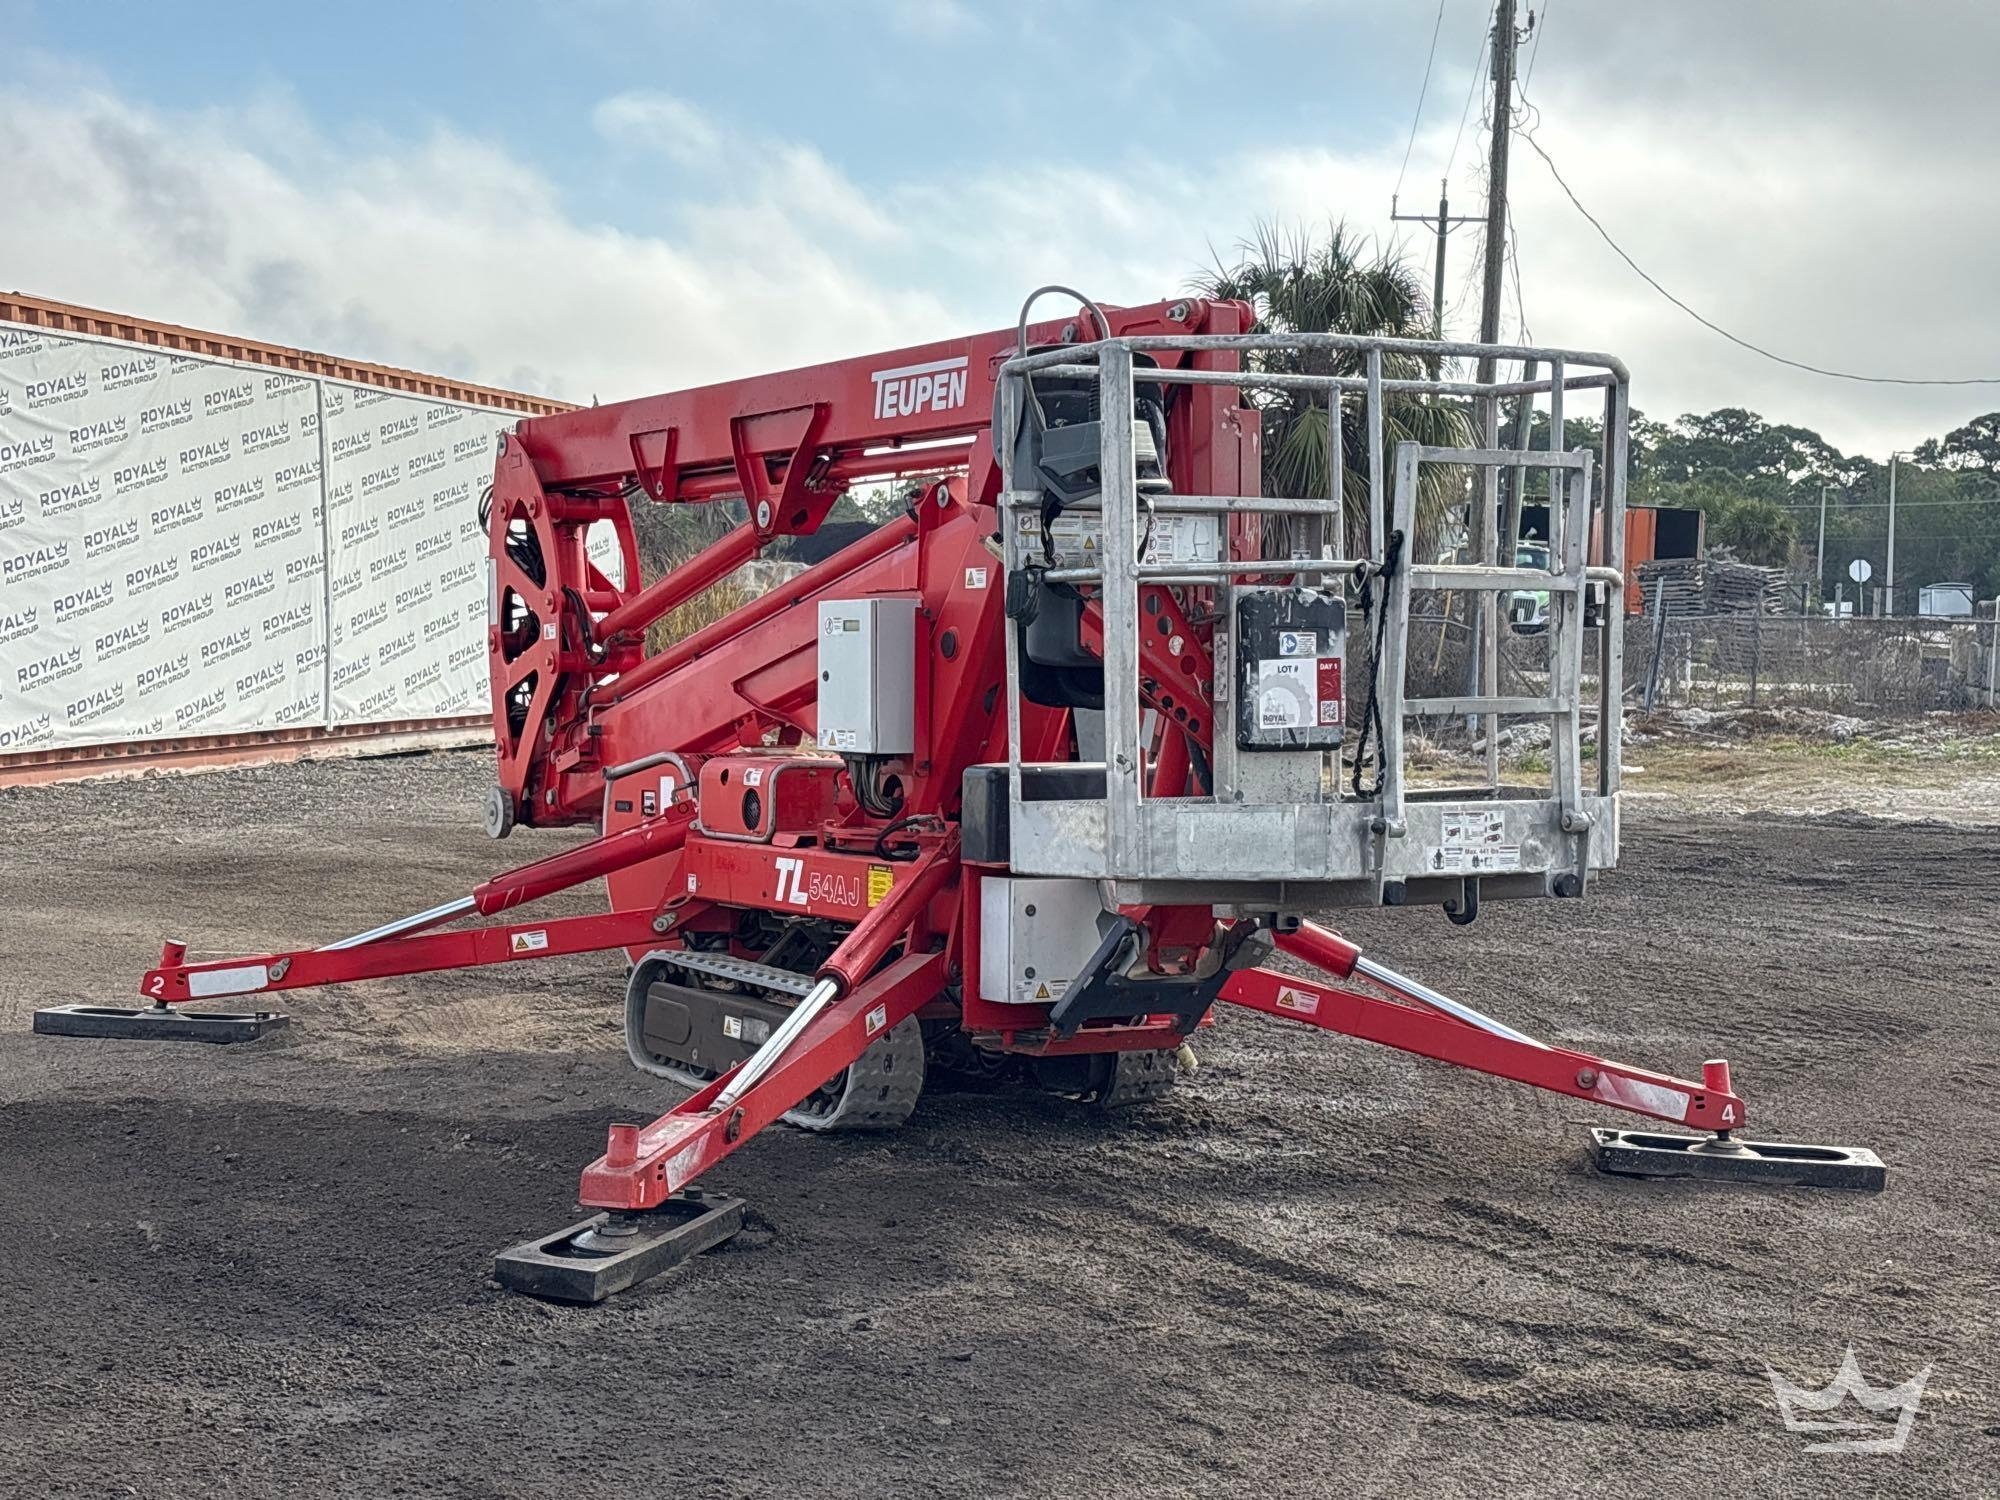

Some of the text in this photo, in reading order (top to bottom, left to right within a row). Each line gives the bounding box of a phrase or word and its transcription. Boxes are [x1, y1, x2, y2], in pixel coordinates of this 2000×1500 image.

[15, 344, 42, 356] GROUP
[101, 360, 145, 382] ROYAL
[172, 363, 199, 375] AUCTION
[26, 377, 75, 399] ROYAL
[104, 372, 157, 392] AUCTION GROUP
[292, 383, 311, 393] GROUP
[871, 356, 968, 419] TEUPEN
[29, 389, 88, 409] AUCTION GROUP
[204, 386, 243, 407] ROYAL
[206, 398, 254, 416] AUCTION GROUP
[140, 403, 181, 425] ROYAL
[142, 414, 193, 434] AUCTION GROUP
[427, 405, 455, 421] ROYAL
[70, 421, 115, 444] ROYAL
[242, 425, 279, 445] ROYAL
[380, 418, 410, 436] ROYAL
[73, 433, 128, 454] AUCTION GROUP
[180, 442, 220, 464] ROYAL
[243, 435, 290, 455] AUCTION GROUP
[332, 433, 362, 453] ROYAL
[453, 437, 481, 454] ROYAL
[28, 452, 56, 466] GROUP
[182, 453, 230, 474] AUCTION GROUP
[409, 452, 437, 470] ROYAL
[114, 462, 156, 484] ROYAL
[116, 473, 168, 494] AUCTION GROUP
[275, 462, 312, 484] ROYAL
[361, 468, 391, 488] ROYAL
[40, 482, 89, 507] ROYAL
[214, 481, 253, 504] ROYAL
[277, 479, 302, 492] AUCTION
[433, 485, 461, 504] ROYAL
[42, 494, 102, 517] AUCTION GROUP
[151, 502, 191, 525] ROYAL
[216, 492, 264, 513] AUCTION GROUP
[387, 502, 416, 521] ROYAL
[153, 512, 203, 535] AUCTION GROUP
[252, 517, 290, 539] ROYAL
[342, 520, 370, 541] ROYAL
[84, 524, 127, 548] ROYAL
[86, 535, 139, 559] AUCTION GROUP
[254, 526, 301, 548] AUCTION GROUP
[416, 533, 444, 553] ROYAL
[3, 548, 54, 574] ROYAL
[191, 539, 230, 562] ROYAL
[192, 549, 241, 571] AUCTION GROUP
[6, 559, 70, 585] AUCTION GROUP
[126, 562, 167, 587] ROYAL
[286, 553, 324, 575] ROYAL
[370, 553, 399, 574] ROYAL
[128, 572, 179, 597] AUCTION GROUP
[287, 569, 314, 584] AUCTION
[440, 565, 468, 585] ROYAL
[225, 575, 264, 599] ROYAL
[226, 584, 275, 608] AUCTION GROUP
[395, 585, 424, 606] ROYAL
[54, 587, 101, 614] ROYAL
[56, 597, 114, 624] AUCTION GROUP
[162, 599, 202, 625] ROYAL
[163, 608, 214, 634] AUCTION GROUP
[262, 608, 301, 632] ROYAL
[351, 606, 379, 628] ROYAL
[11, 624, 39, 640] GROUP
[264, 616, 313, 641] AUCTION GROUP
[424, 614, 452, 635] ROYAL
[95, 625, 138, 652] ROYAL
[98, 635, 150, 662] AUCTION GROUP
[201, 632, 241, 659] ROYAL
[379, 636, 407, 658] ROYAL
[203, 641, 252, 667] AUCTION GROUP
[449, 644, 476, 665] ROYAL
[17, 654, 68, 683] ROYAL
[20, 663, 83, 693] AUCTION GROUP
[137, 660, 178, 687] ROYAL
[333, 659, 362, 683] ROYAL
[404, 666, 433, 688] ROYAL
[1277, 665, 1299, 673] LOT #
[139, 669, 190, 696] AUCTION GROUP
[236, 667, 274, 693] ROYAL
[239, 675, 285, 701] AUCTION GROUP
[66, 689, 112, 718] ROYAL
[69, 698, 124, 727] AUCTION GROUP
[175, 694, 215, 722] ROYAL
[275, 697, 311, 723] ROYAL
[360, 690, 388, 713] ROYAL
[178, 702, 226, 730] AUCTION GROUP
[1263, 714, 1287, 722] ROYAL
[775, 857, 808, 905] TL
[809, 872, 860, 906] 54AJ
[150, 977, 164, 995] 2
[1721, 1103, 1736, 1124] 4
[639, 1181, 645, 1203] 1
